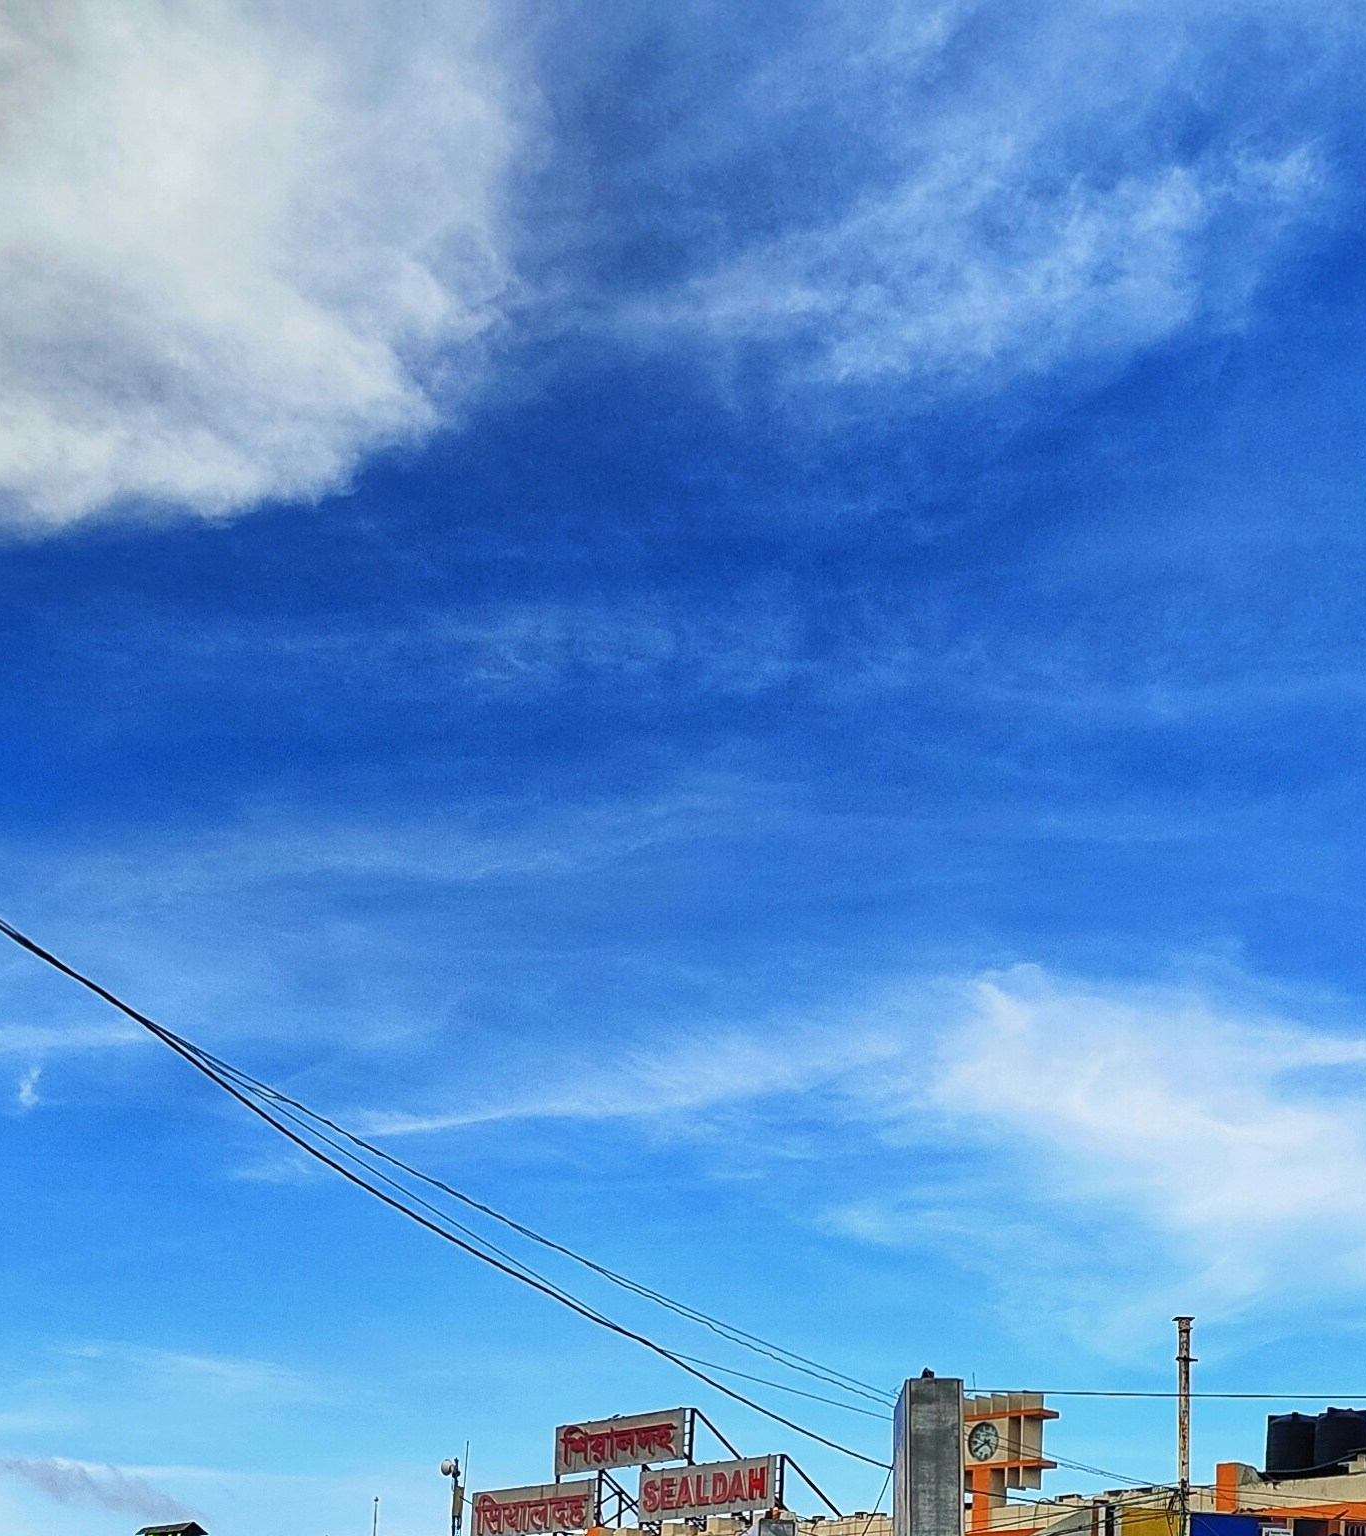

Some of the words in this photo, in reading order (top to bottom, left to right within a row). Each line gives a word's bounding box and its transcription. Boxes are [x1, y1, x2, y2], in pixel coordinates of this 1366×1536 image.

[559, 1422, 678, 1467] শিয়ালদহ
[643, 1466, 768, 1513] SEALDAH
[475, 1492, 590, 1536] सियालदह
